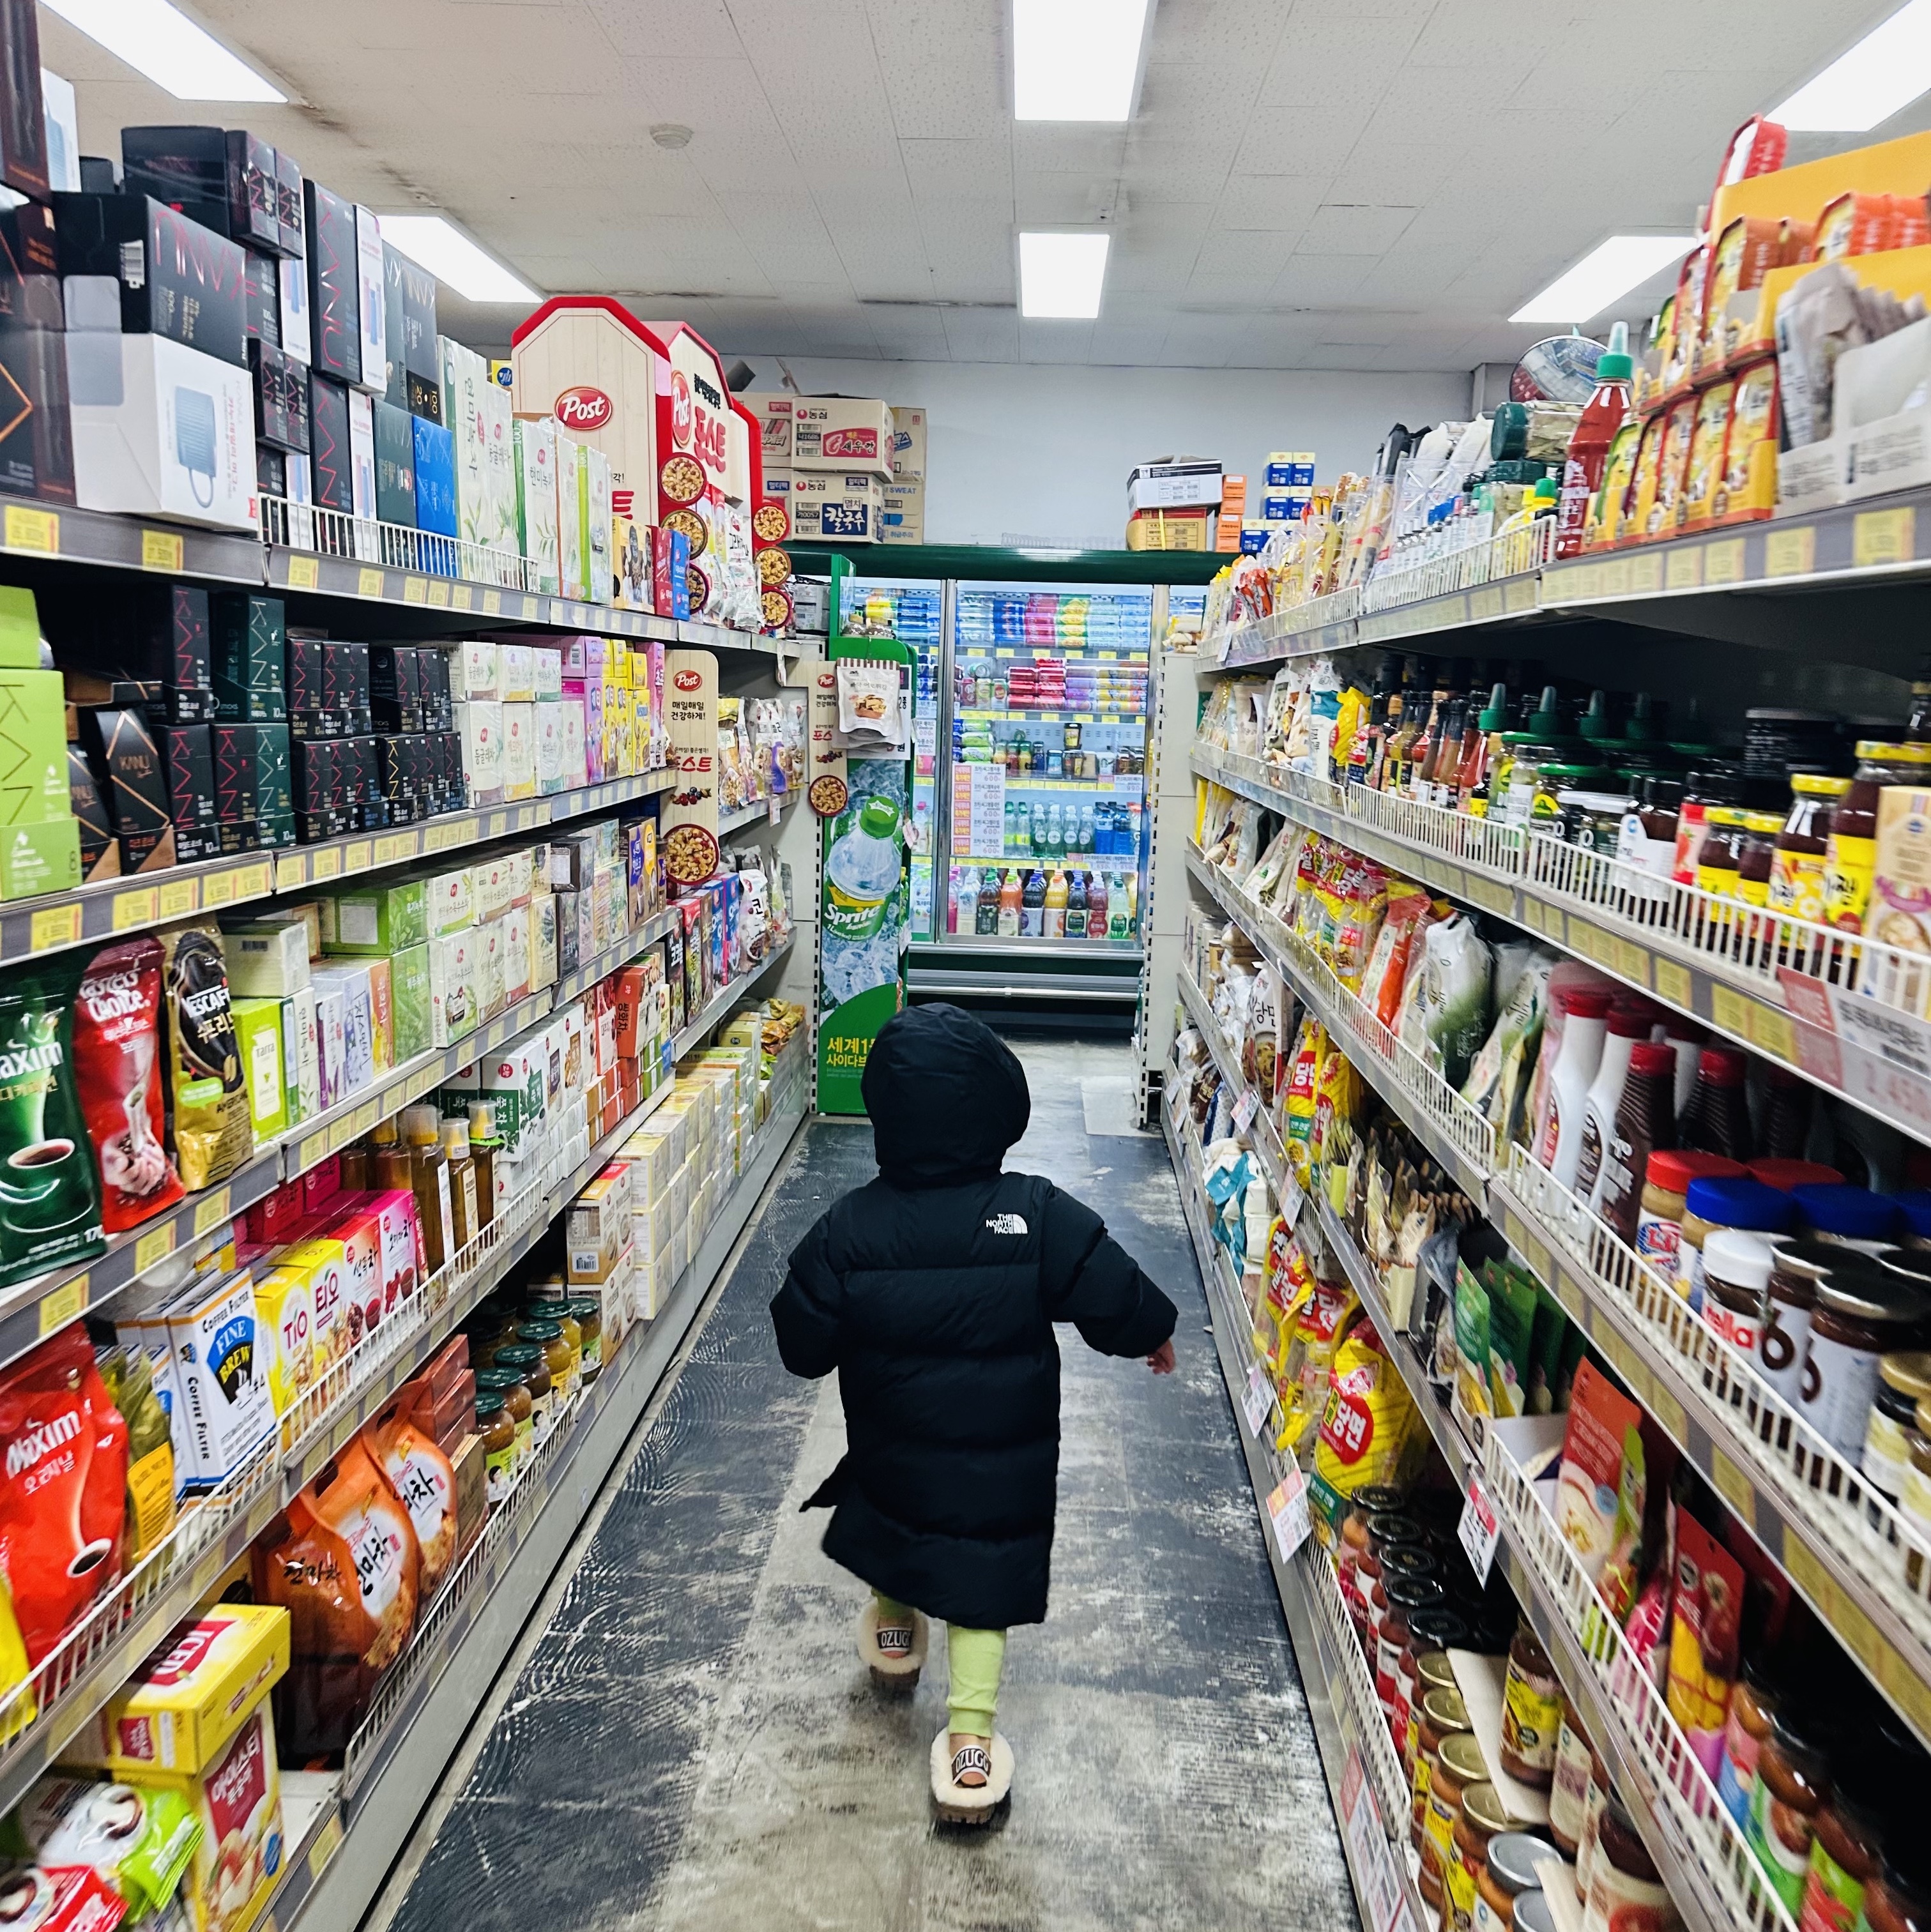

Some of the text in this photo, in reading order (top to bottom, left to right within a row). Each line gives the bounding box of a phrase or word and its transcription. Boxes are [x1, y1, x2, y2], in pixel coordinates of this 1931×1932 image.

[561, 395, 606, 423] Post
[673, 386, 690, 427] Post
[809, 411, 828, 419] 농심
[694, 406, 726, 473] 포스트
[841, 440, 875, 454] 새우깡
[844, 499, 861, 510] 멸치
[825, 507, 866, 533] 칼국수
[676, 674, 699, 687] Post
[671, 710, 706, 720] 건강하게!
[672, 701, 705, 711] 매일매일
[824, 902, 881, 926] Sprite
[0, 1041, 63, 1079] axim
[986, 1219, 1013, 1228] NORTH
[997, 1213, 1014, 1222] THE
[994, 1226, 1014, 1235] FACE
[316, 1272, 340, 1314] 티오
[216, 1320, 247, 1357] FINE
[219, 1344, 252, 1385] BREW
[6, 1410, 82, 1480] Maxim
